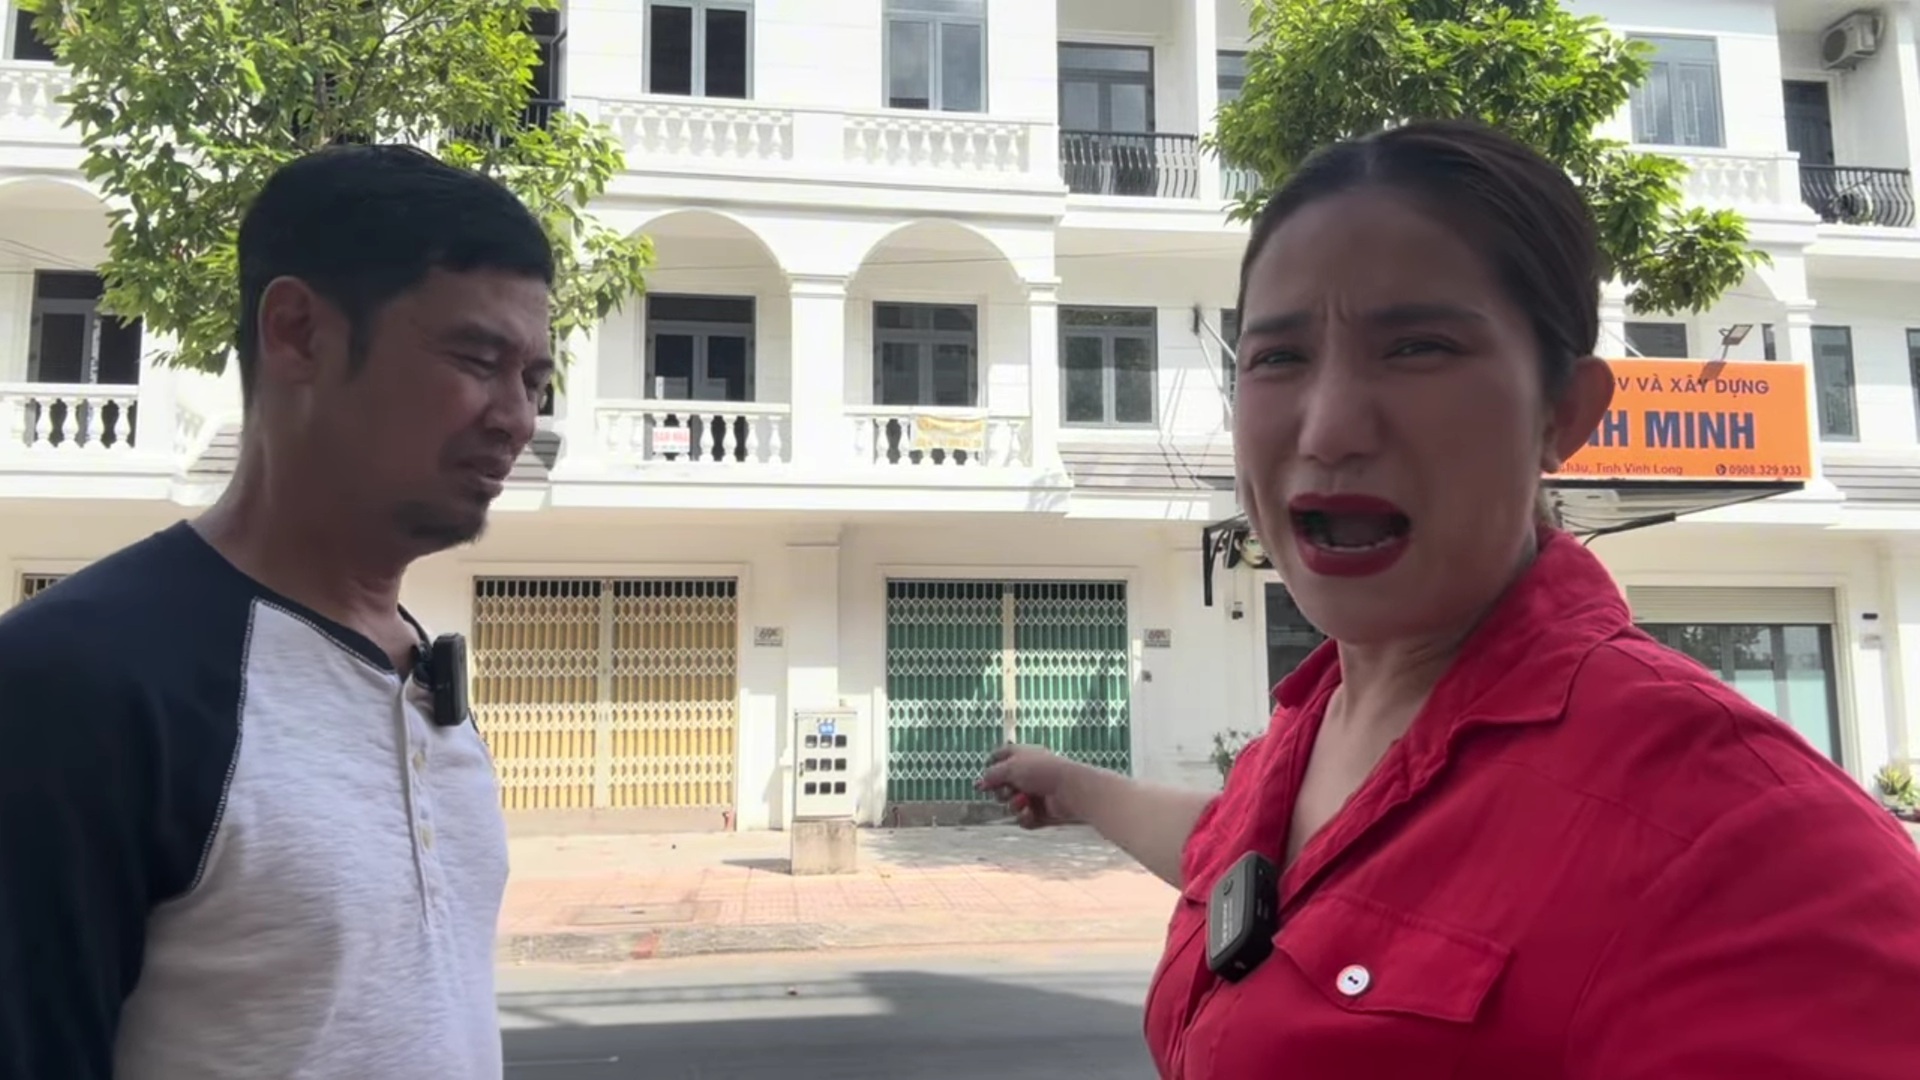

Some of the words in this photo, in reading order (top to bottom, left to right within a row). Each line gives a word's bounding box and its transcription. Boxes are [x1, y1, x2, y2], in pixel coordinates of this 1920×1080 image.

[1636, 373, 1664, 393] VÀ
[1670, 374, 1709, 394] XÂY
[1714, 378, 1770, 399] DỰNG
[1644, 410, 1755, 450] MINH
[1653, 462, 1684, 476] Long
